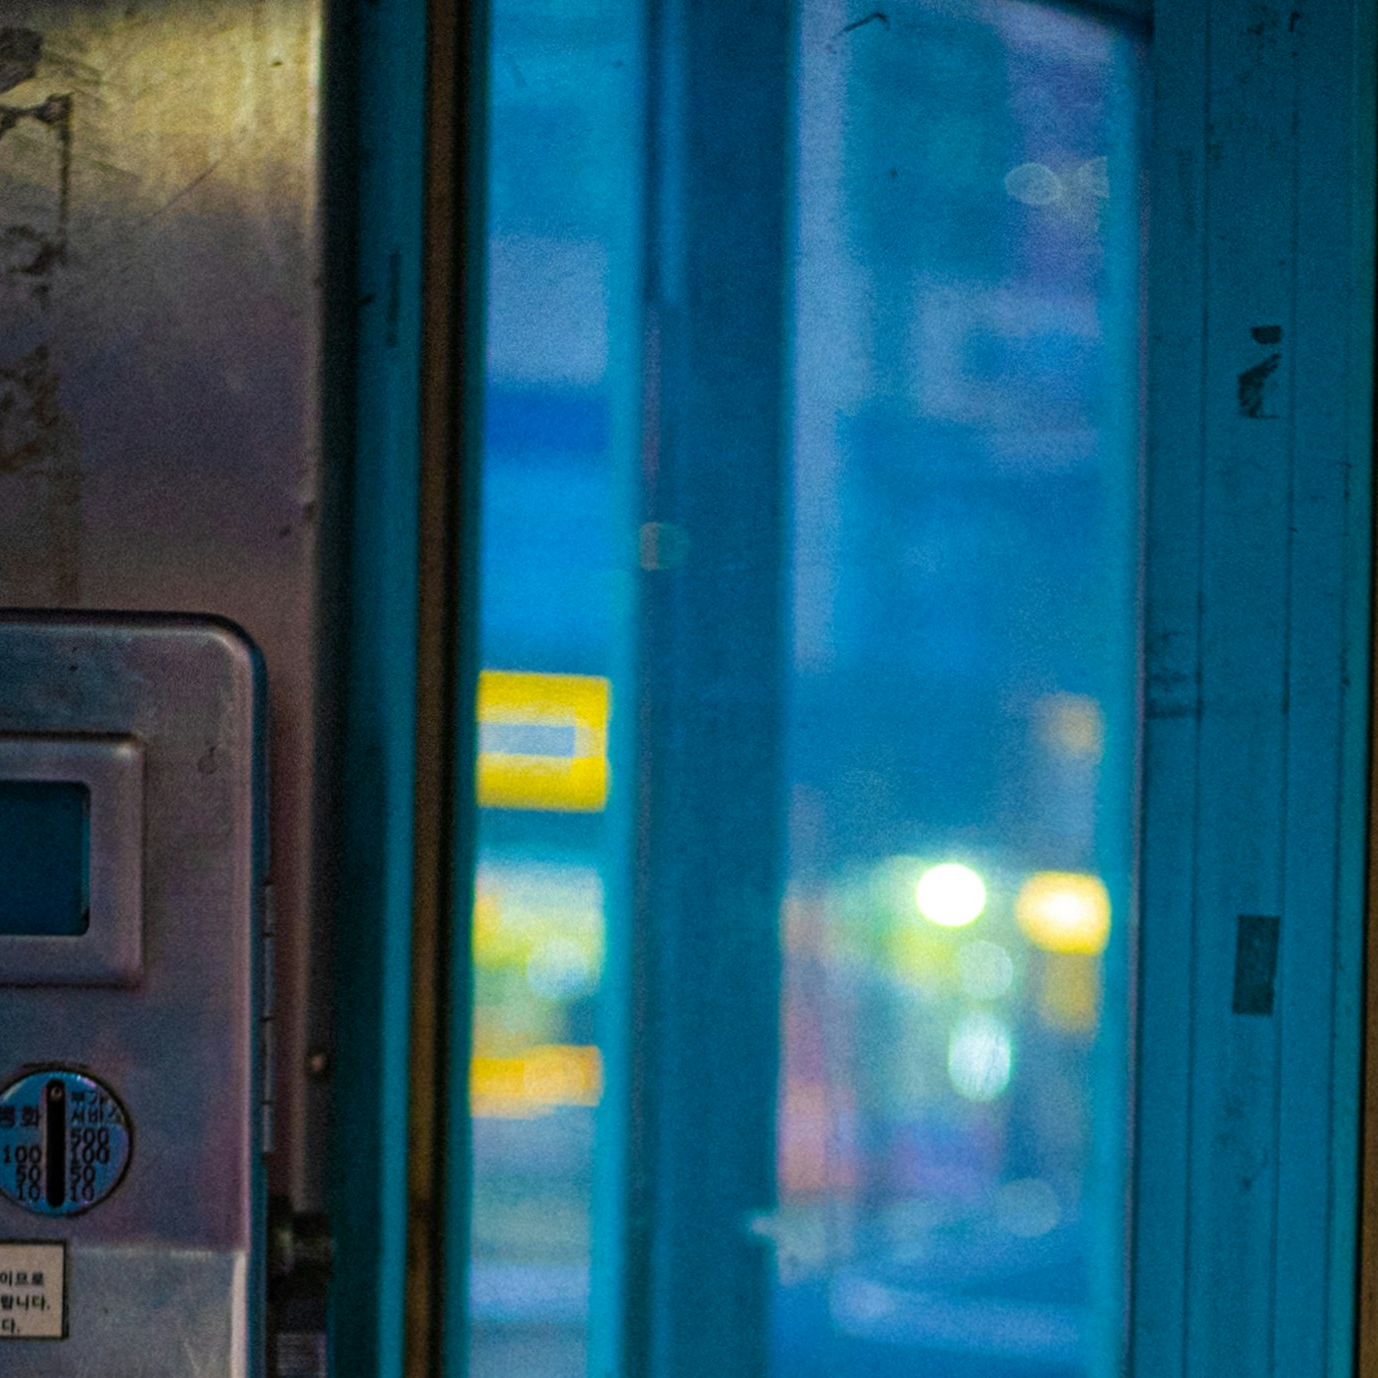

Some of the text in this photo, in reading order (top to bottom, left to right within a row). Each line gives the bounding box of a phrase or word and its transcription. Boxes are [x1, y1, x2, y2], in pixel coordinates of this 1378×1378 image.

[72, 1127, 109, 1147] 500
[4, 1145, 41, 1163] 100
[72, 1146, 109, 1164] 100
[16, 1165, 41, 1183] 50
[72, 1165, 94, 1183] 50
[18, 1183, 40, 1201] 10
[72, 1183, 94, 1201] 10
